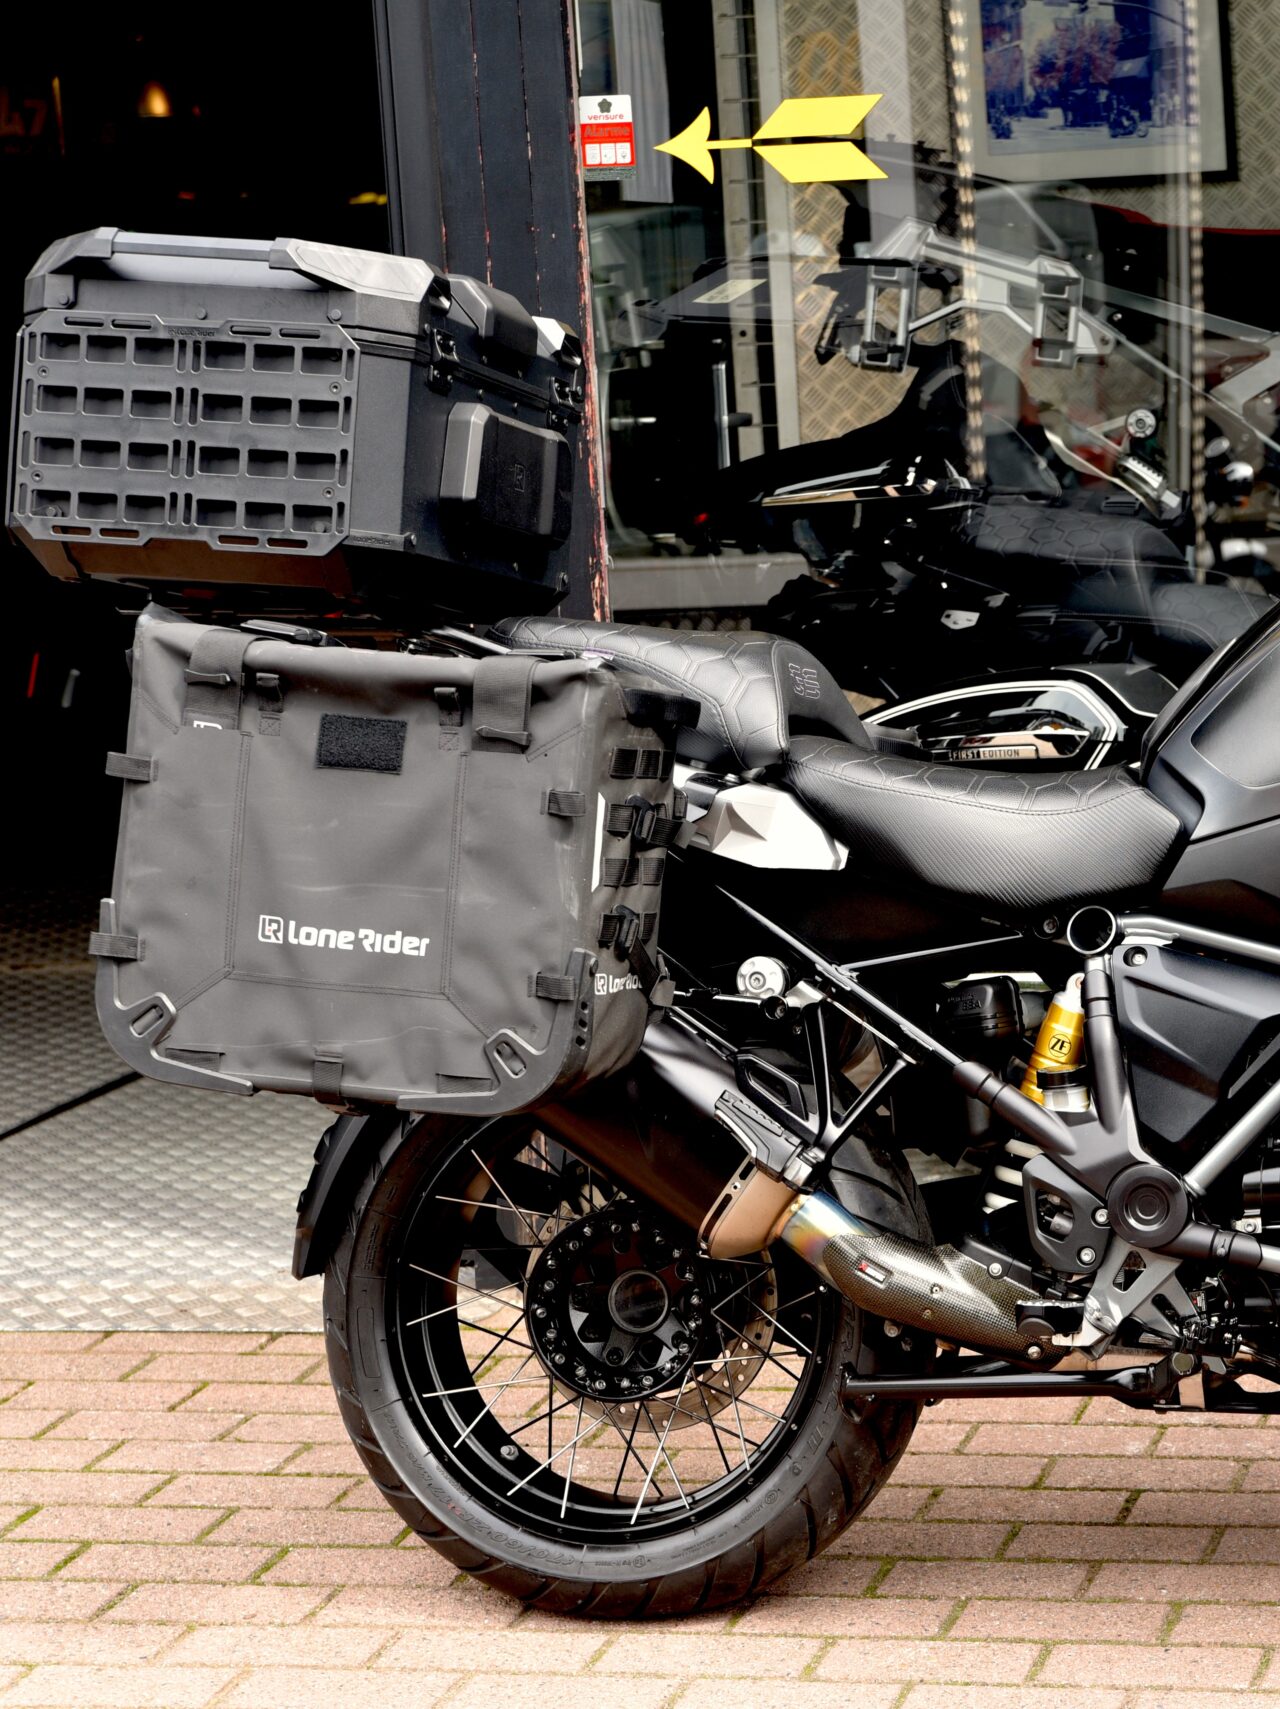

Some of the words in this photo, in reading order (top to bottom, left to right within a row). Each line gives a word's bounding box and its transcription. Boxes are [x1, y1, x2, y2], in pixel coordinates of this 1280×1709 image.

[587, 113, 625, 121] verisure
[953, 750, 978, 760] FIRST
[982, 748, 1020, 758] EDITION
[288, 920, 356, 950] Lone
[358, 928, 430, 957] Rider
